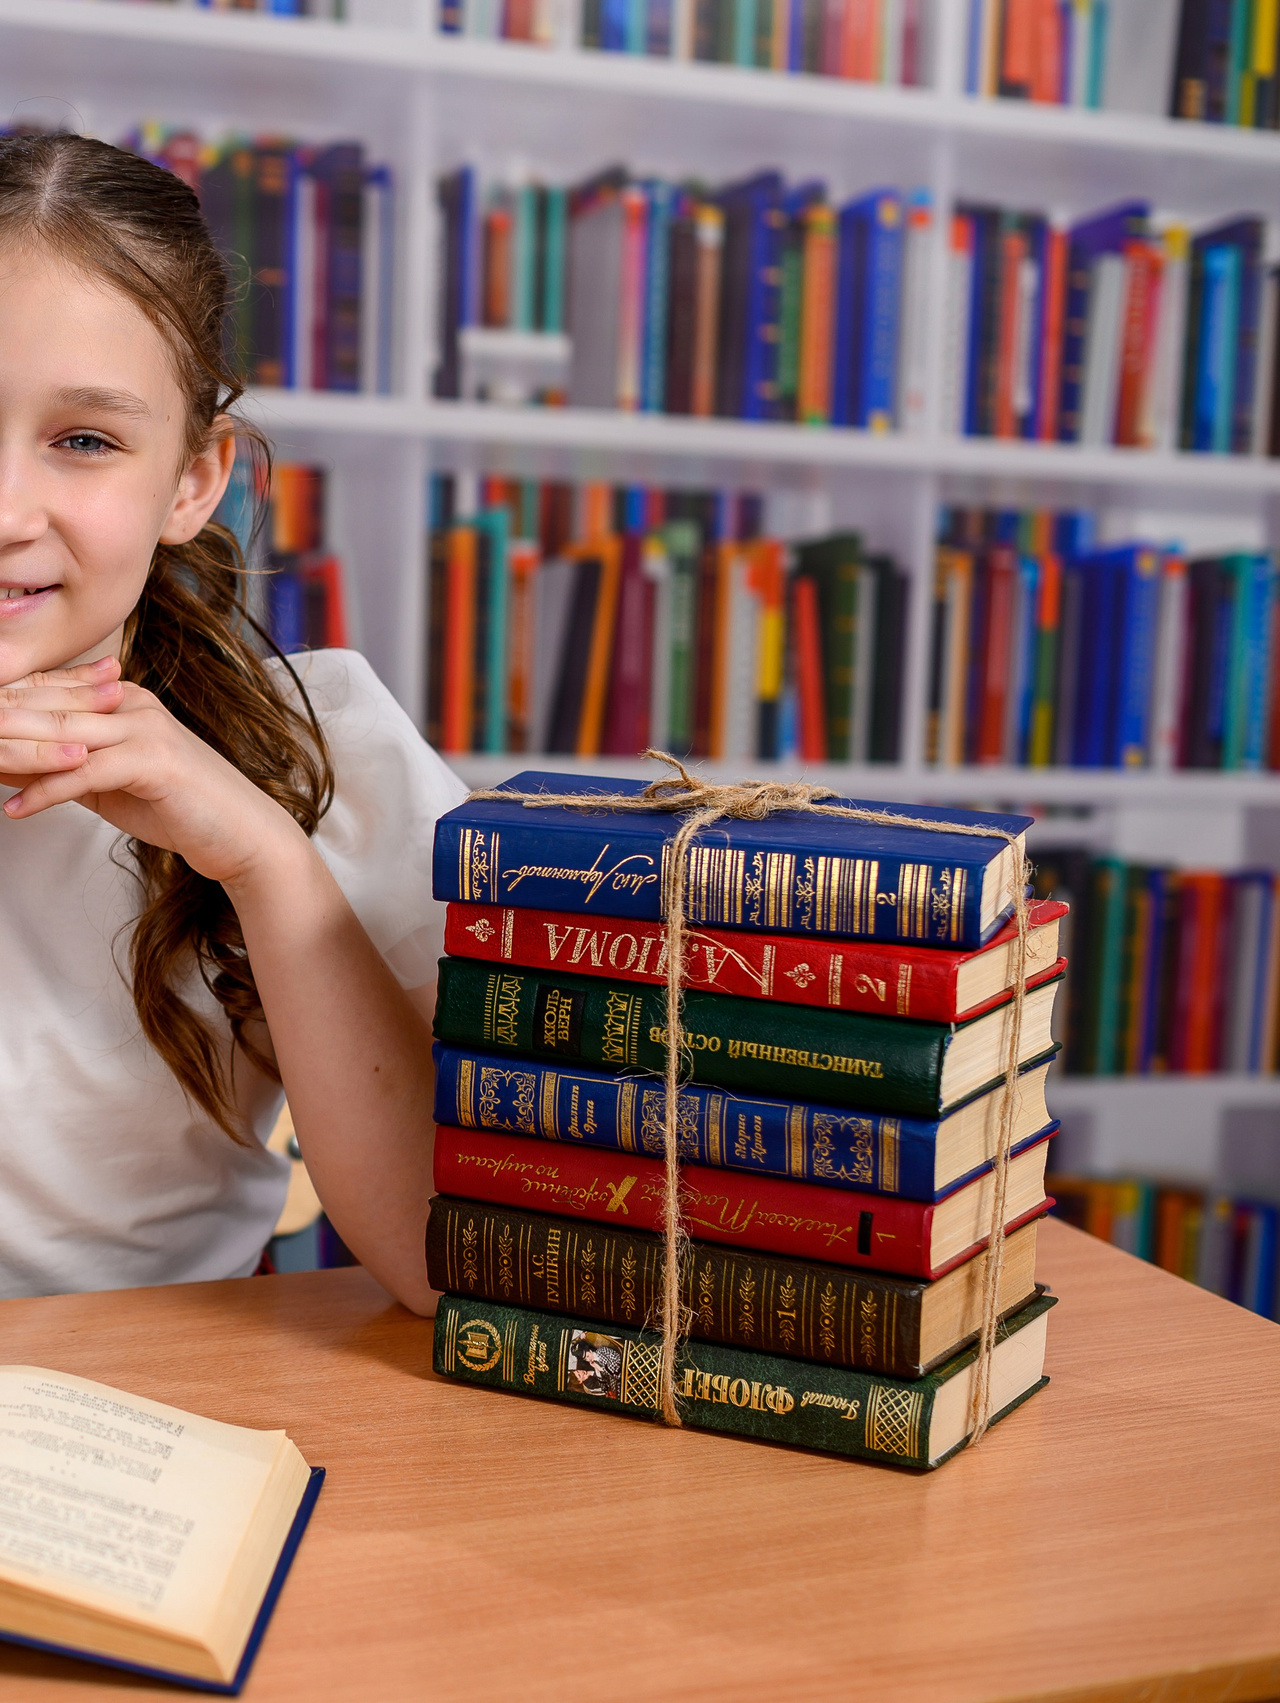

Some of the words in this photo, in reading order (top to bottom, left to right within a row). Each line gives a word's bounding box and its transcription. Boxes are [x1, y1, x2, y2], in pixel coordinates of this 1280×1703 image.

[502, 844, 654, 904] Лермонтов
[876, 892, 897, 906] 2
[854, 973, 887, 1002] 2
[543, 989, 560, 1047] ЖЮЛЬ
[558, 996, 573, 1042] ВЕРН
[726, 1039, 884, 1079] ТАИНСТВЕННЫЙ
[568, 1084, 583, 1139] Филипп
[734, 1113, 751, 1159] Морис
[456, 1153, 533, 1178] мукам
[521, 1174, 638, 1215] Хождение
[640, 1183, 758, 1234] Толсой
[754, 1211, 853, 1247] Алексей
[679, 1368, 795, 1415] ФЛОБЕР
[800, 1390, 861, 1421] Гюстав
